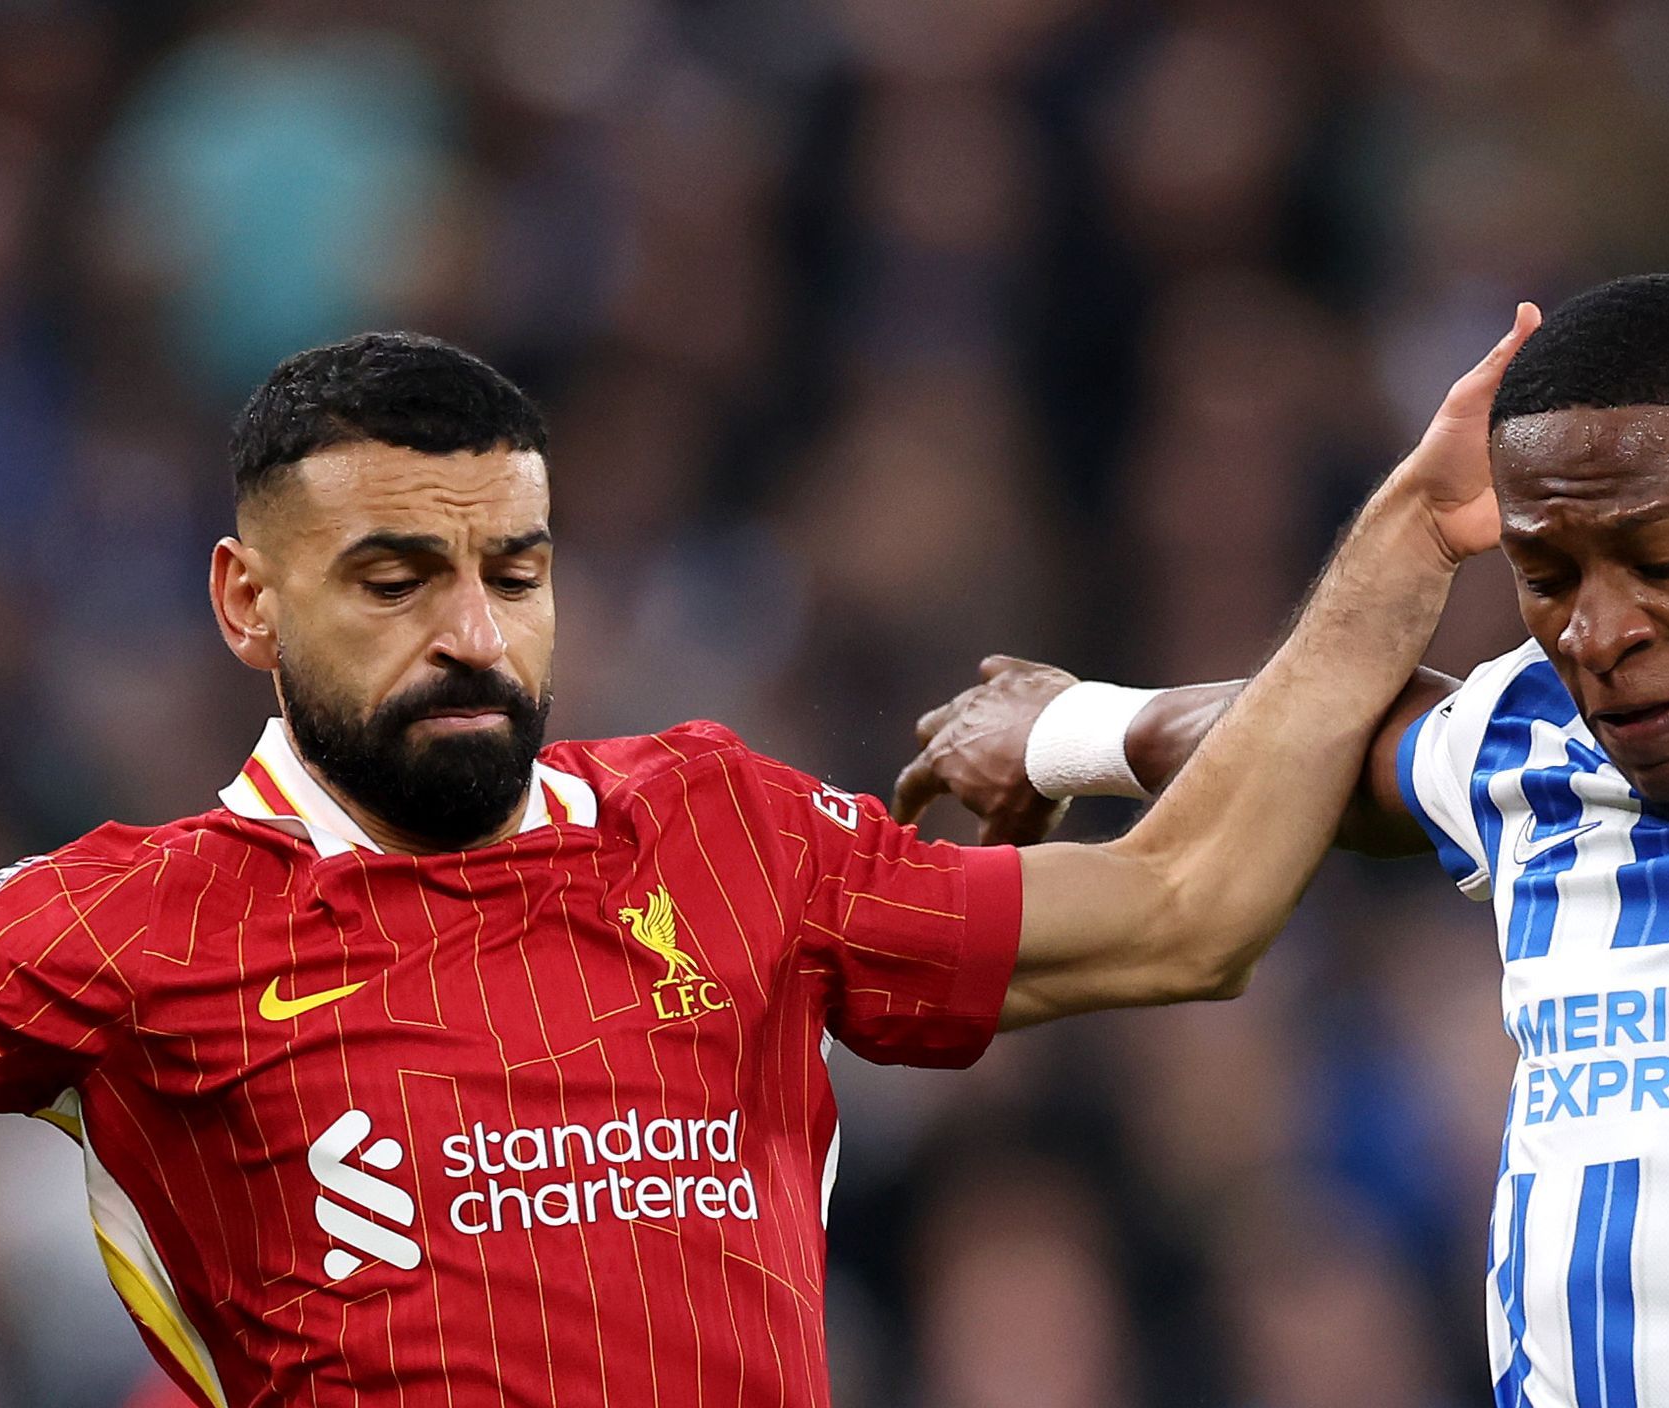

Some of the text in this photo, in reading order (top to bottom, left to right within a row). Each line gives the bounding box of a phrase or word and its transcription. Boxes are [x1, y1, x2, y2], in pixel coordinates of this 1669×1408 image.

[651, 982, 731, 1019] L.F.C.
[442, 1108, 739, 1178] standard
[450, 1167, 759, 1235] chartered
